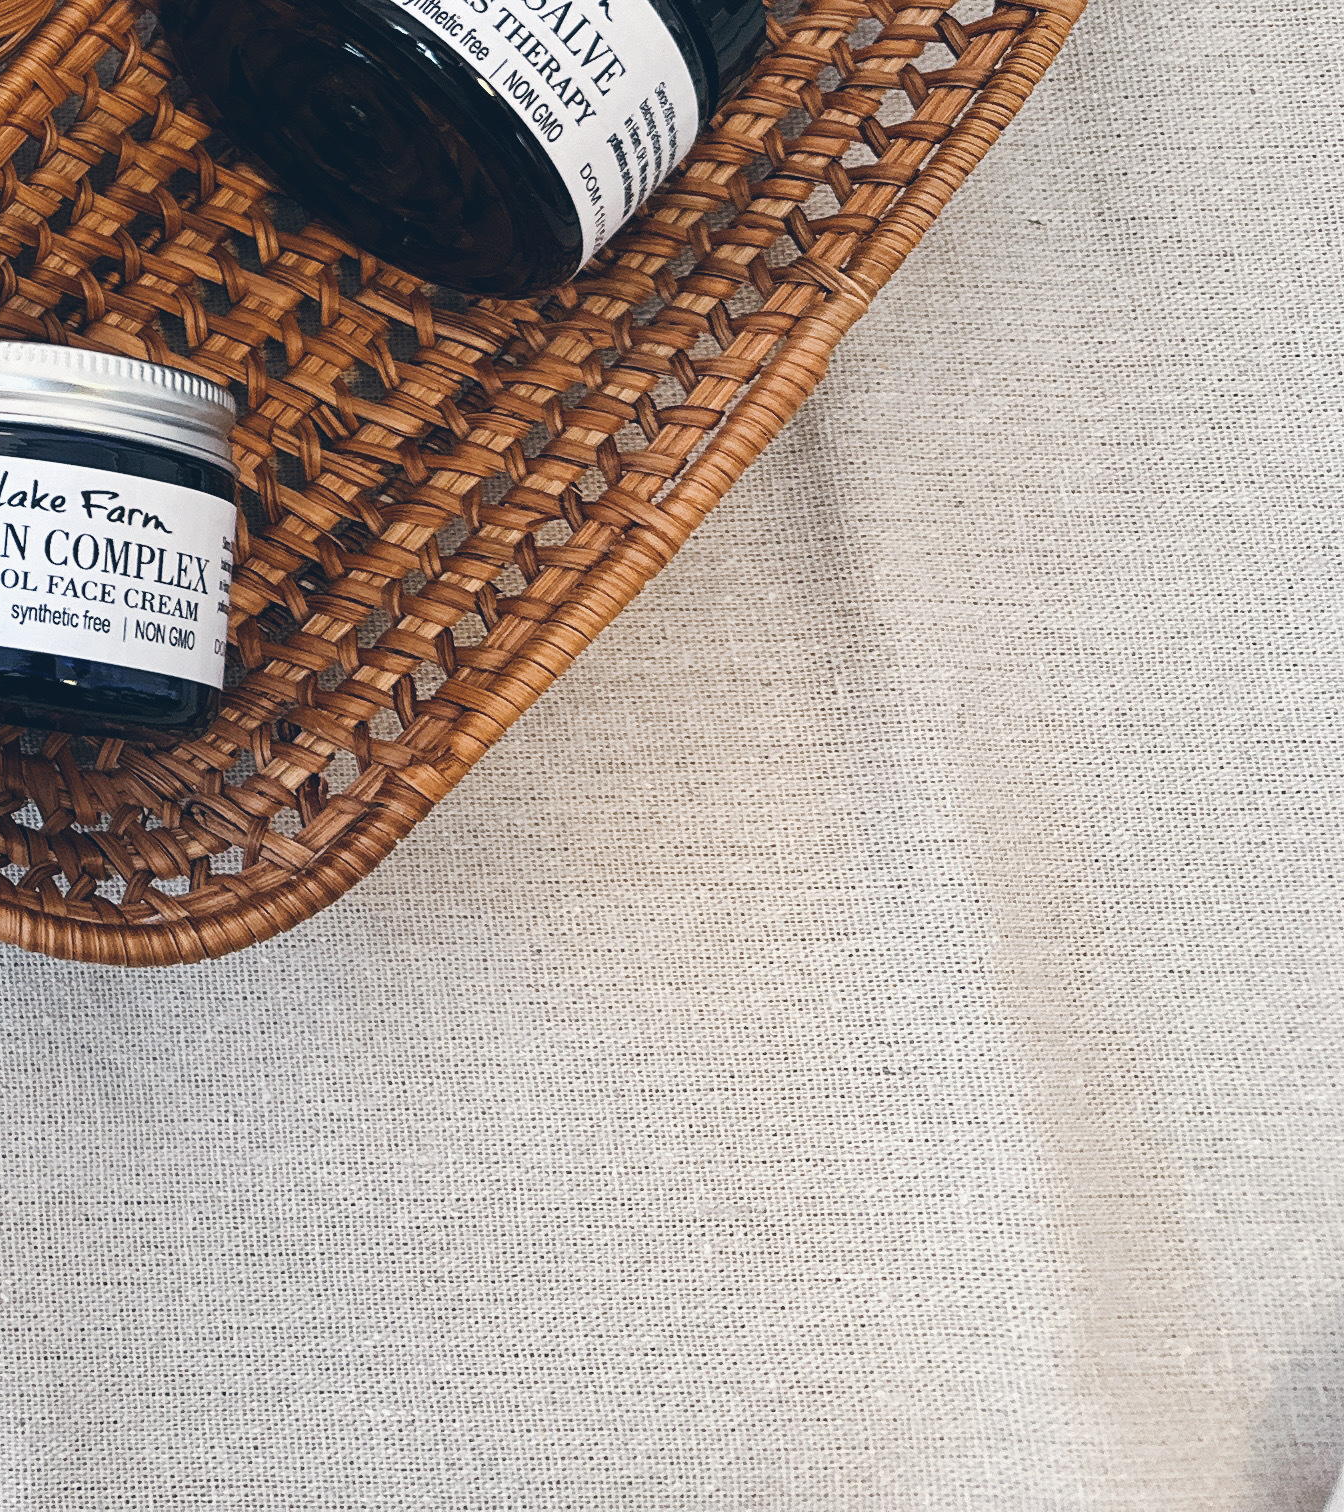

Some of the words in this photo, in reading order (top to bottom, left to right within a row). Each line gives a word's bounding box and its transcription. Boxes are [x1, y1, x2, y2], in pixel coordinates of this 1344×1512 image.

[458, 27, 490, 62] free
[502, 68, 540, 112] NON
[531, 102, 564, 143] GMO
[491, 6, 598, 127] THERAPY
[579, 161, 603, 207] DOM
[80, 489, 173, 535] Farm
[43, 528, 211, 596] COMPLEX
[45, 574, 116, 605] FACE
[123, 587, 199, 622] CREAM
[10, 603, 80, 629] synthetic
[82, 609, 111, 634] free
[134, 619, 167, 645] NON
[168, 625, 196, 651] GMO
